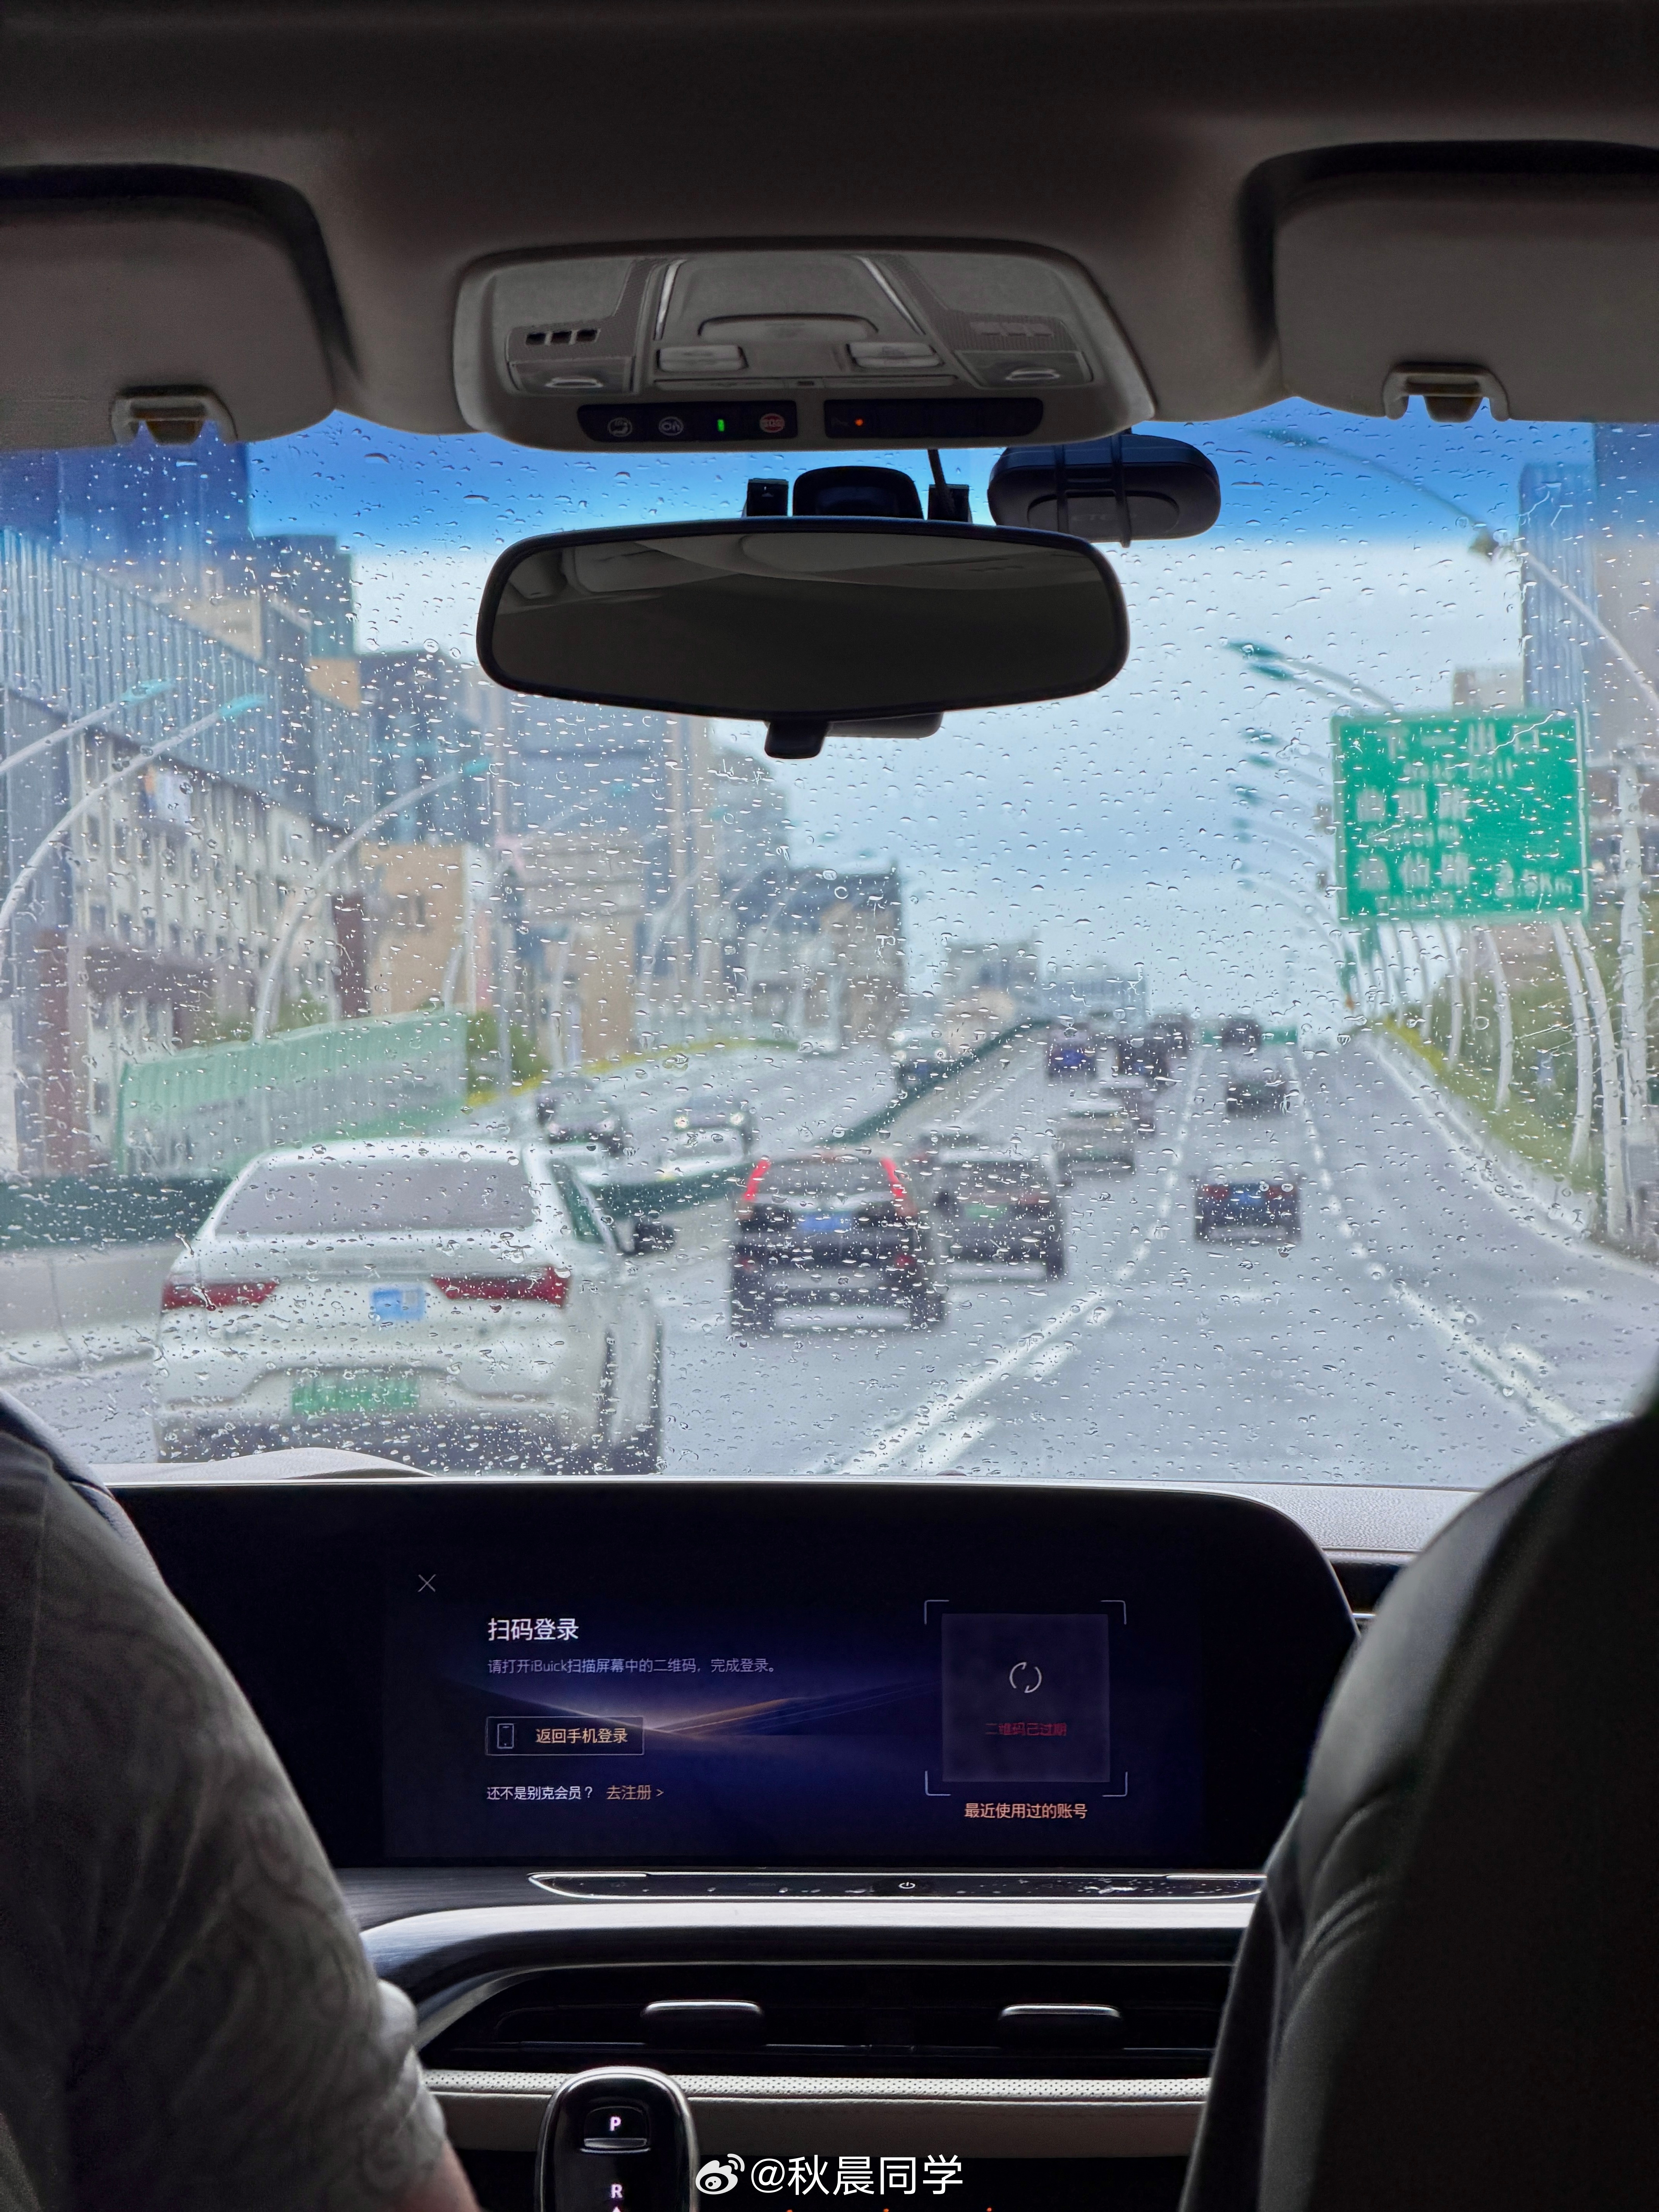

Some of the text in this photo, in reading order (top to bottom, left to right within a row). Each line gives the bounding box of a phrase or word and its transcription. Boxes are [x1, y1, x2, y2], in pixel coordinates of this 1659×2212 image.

[488, 1618, 579, 1641] 扫码登录
[536, 1728, 628, 1744] 返回手机登录
[606, 1785, 652, 1800] 去注册
[965, 1803, 1087, 1819] 最近使用过的账号
[610, 2116, 622, 2131] P
[611, 2183, 623, 2199] R
